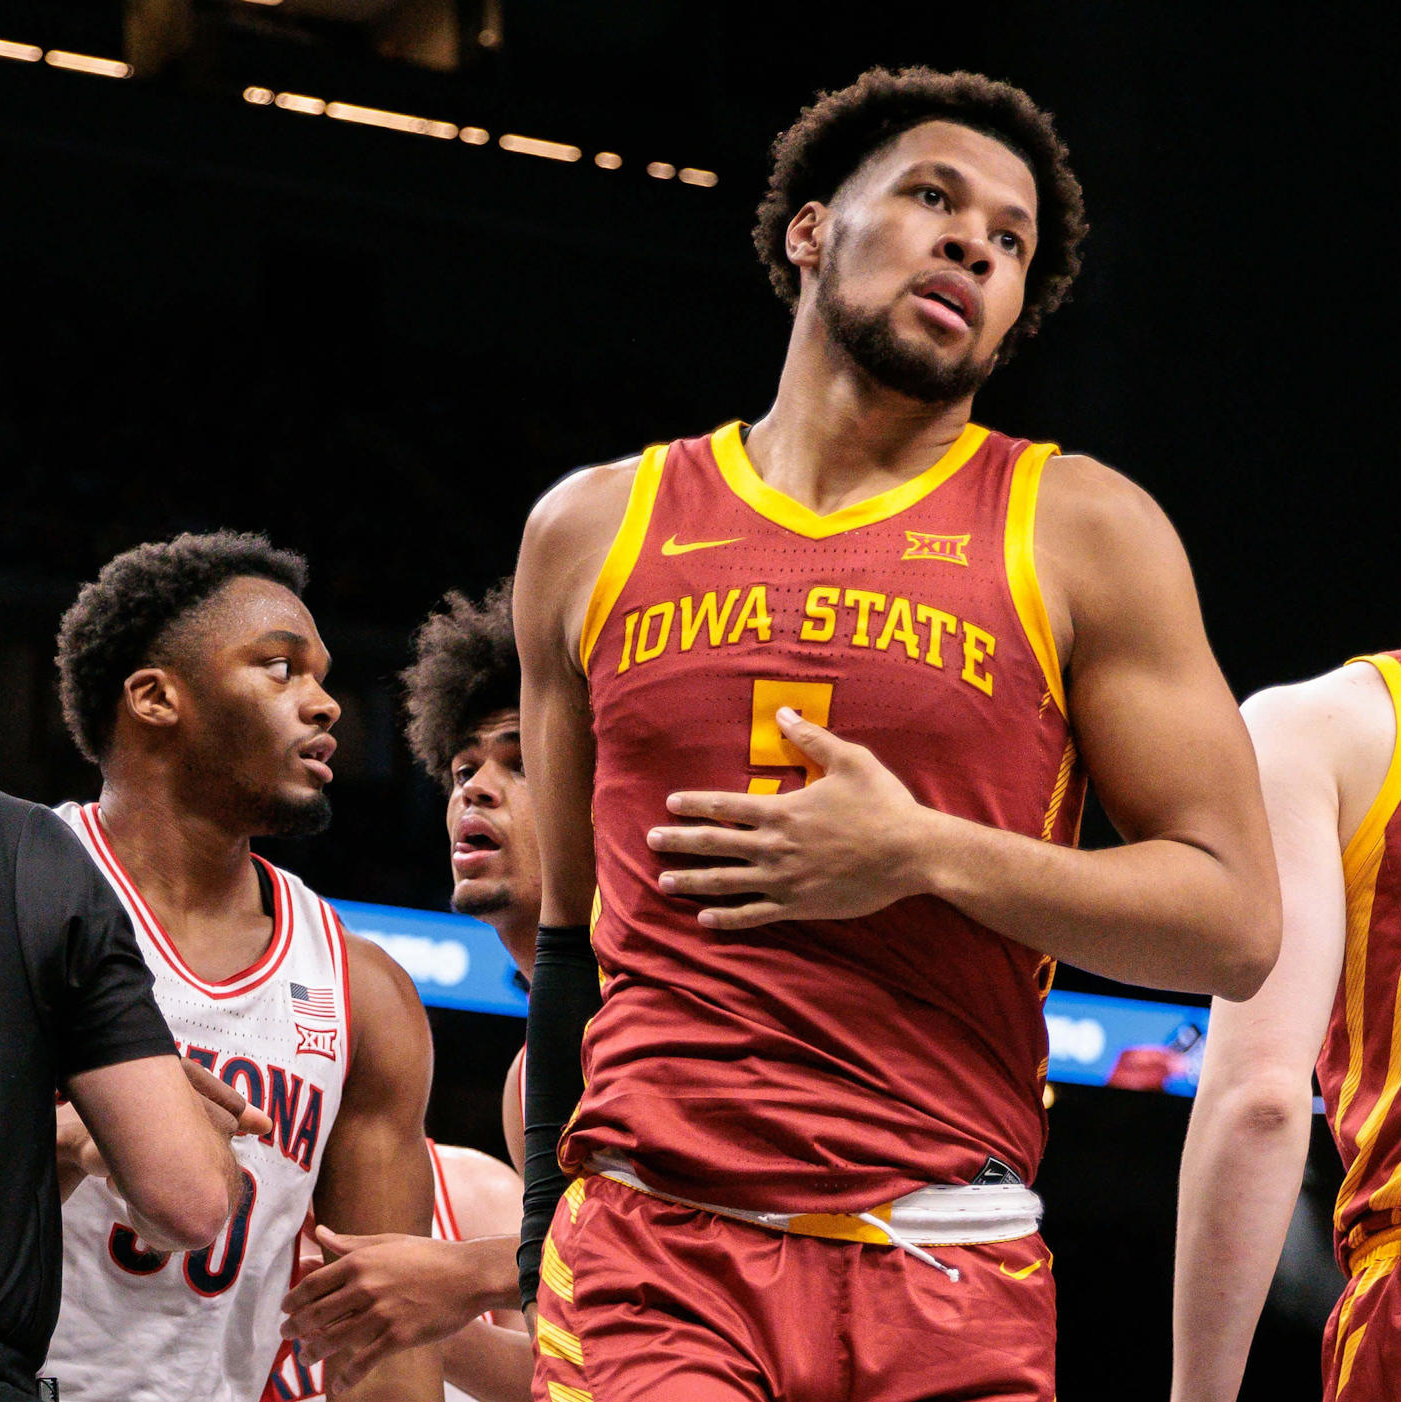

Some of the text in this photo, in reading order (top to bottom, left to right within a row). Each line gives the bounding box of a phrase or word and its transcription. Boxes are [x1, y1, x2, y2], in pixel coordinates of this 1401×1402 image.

[617, 585, 997, 698] IOWA STATE
[747, 680, 834, 796] 5
